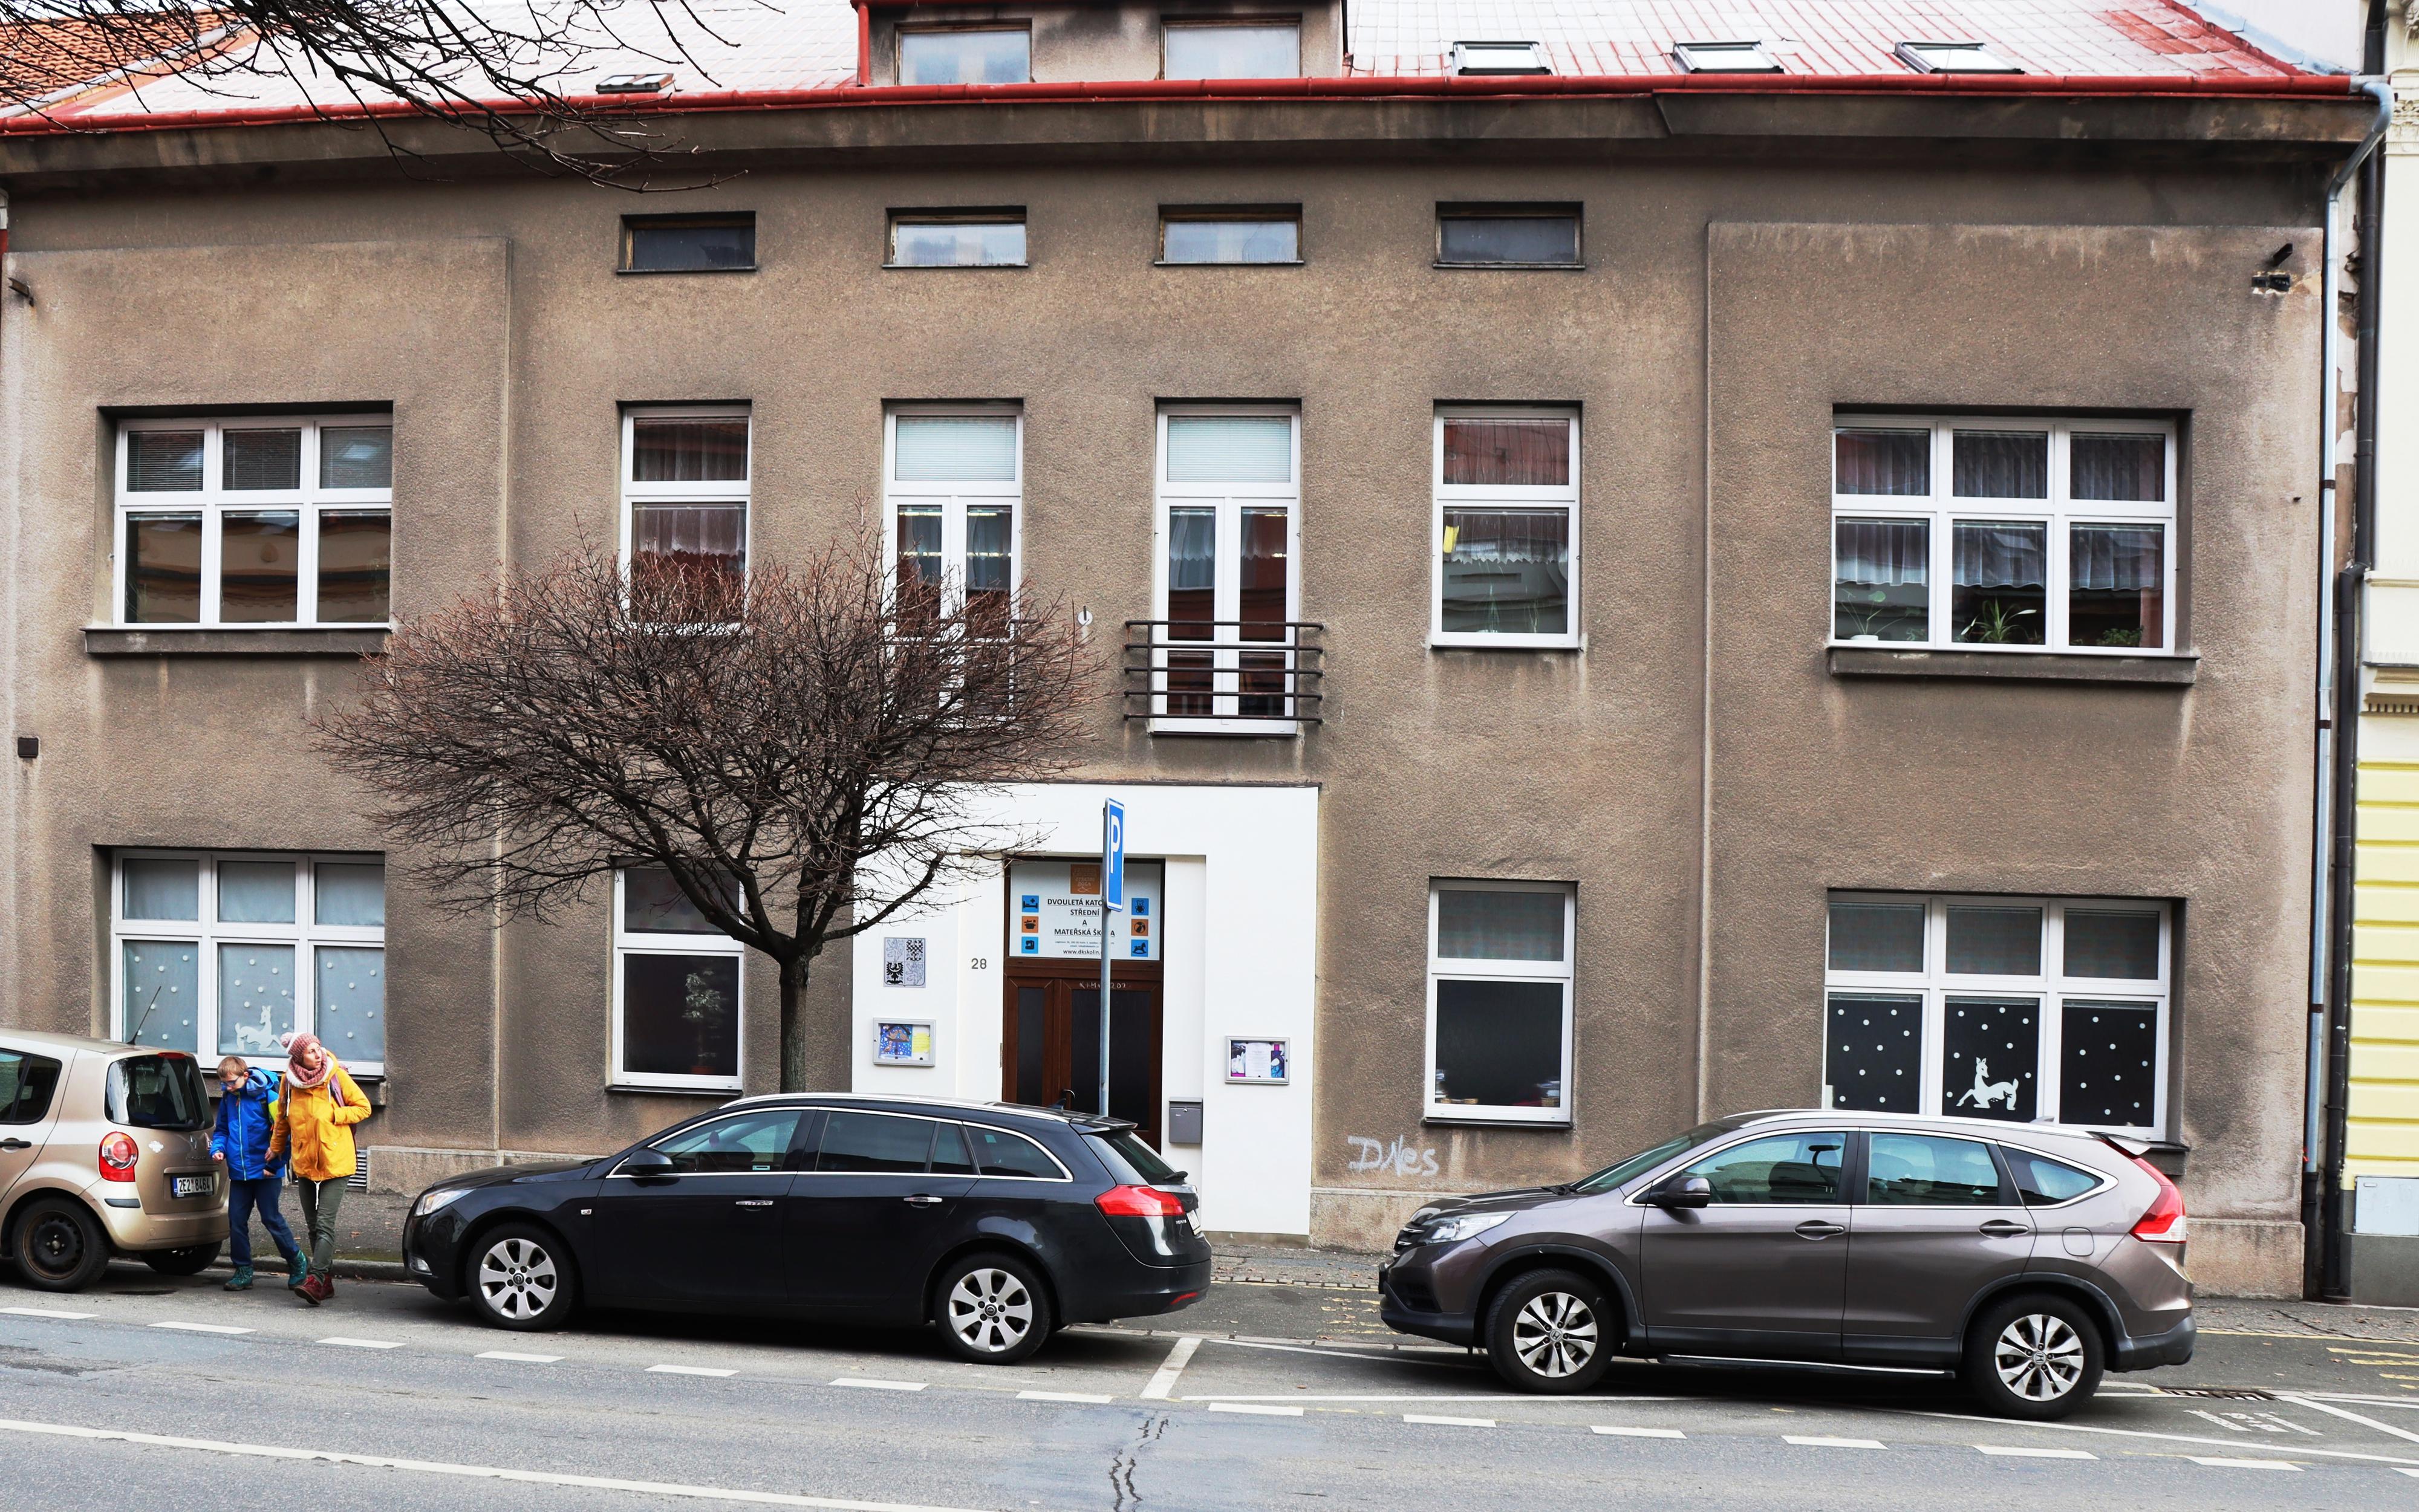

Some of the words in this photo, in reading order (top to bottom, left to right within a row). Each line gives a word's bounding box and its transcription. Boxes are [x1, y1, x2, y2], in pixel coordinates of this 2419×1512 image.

[1110, 814, 1121, 874] P
[1093, 928, 1115, 936] ŠKA
[971, 958, 987, 969] 28
[178, 1179, 191, 1192] 2E2
[195, 1178, 210, 1190] 8464
